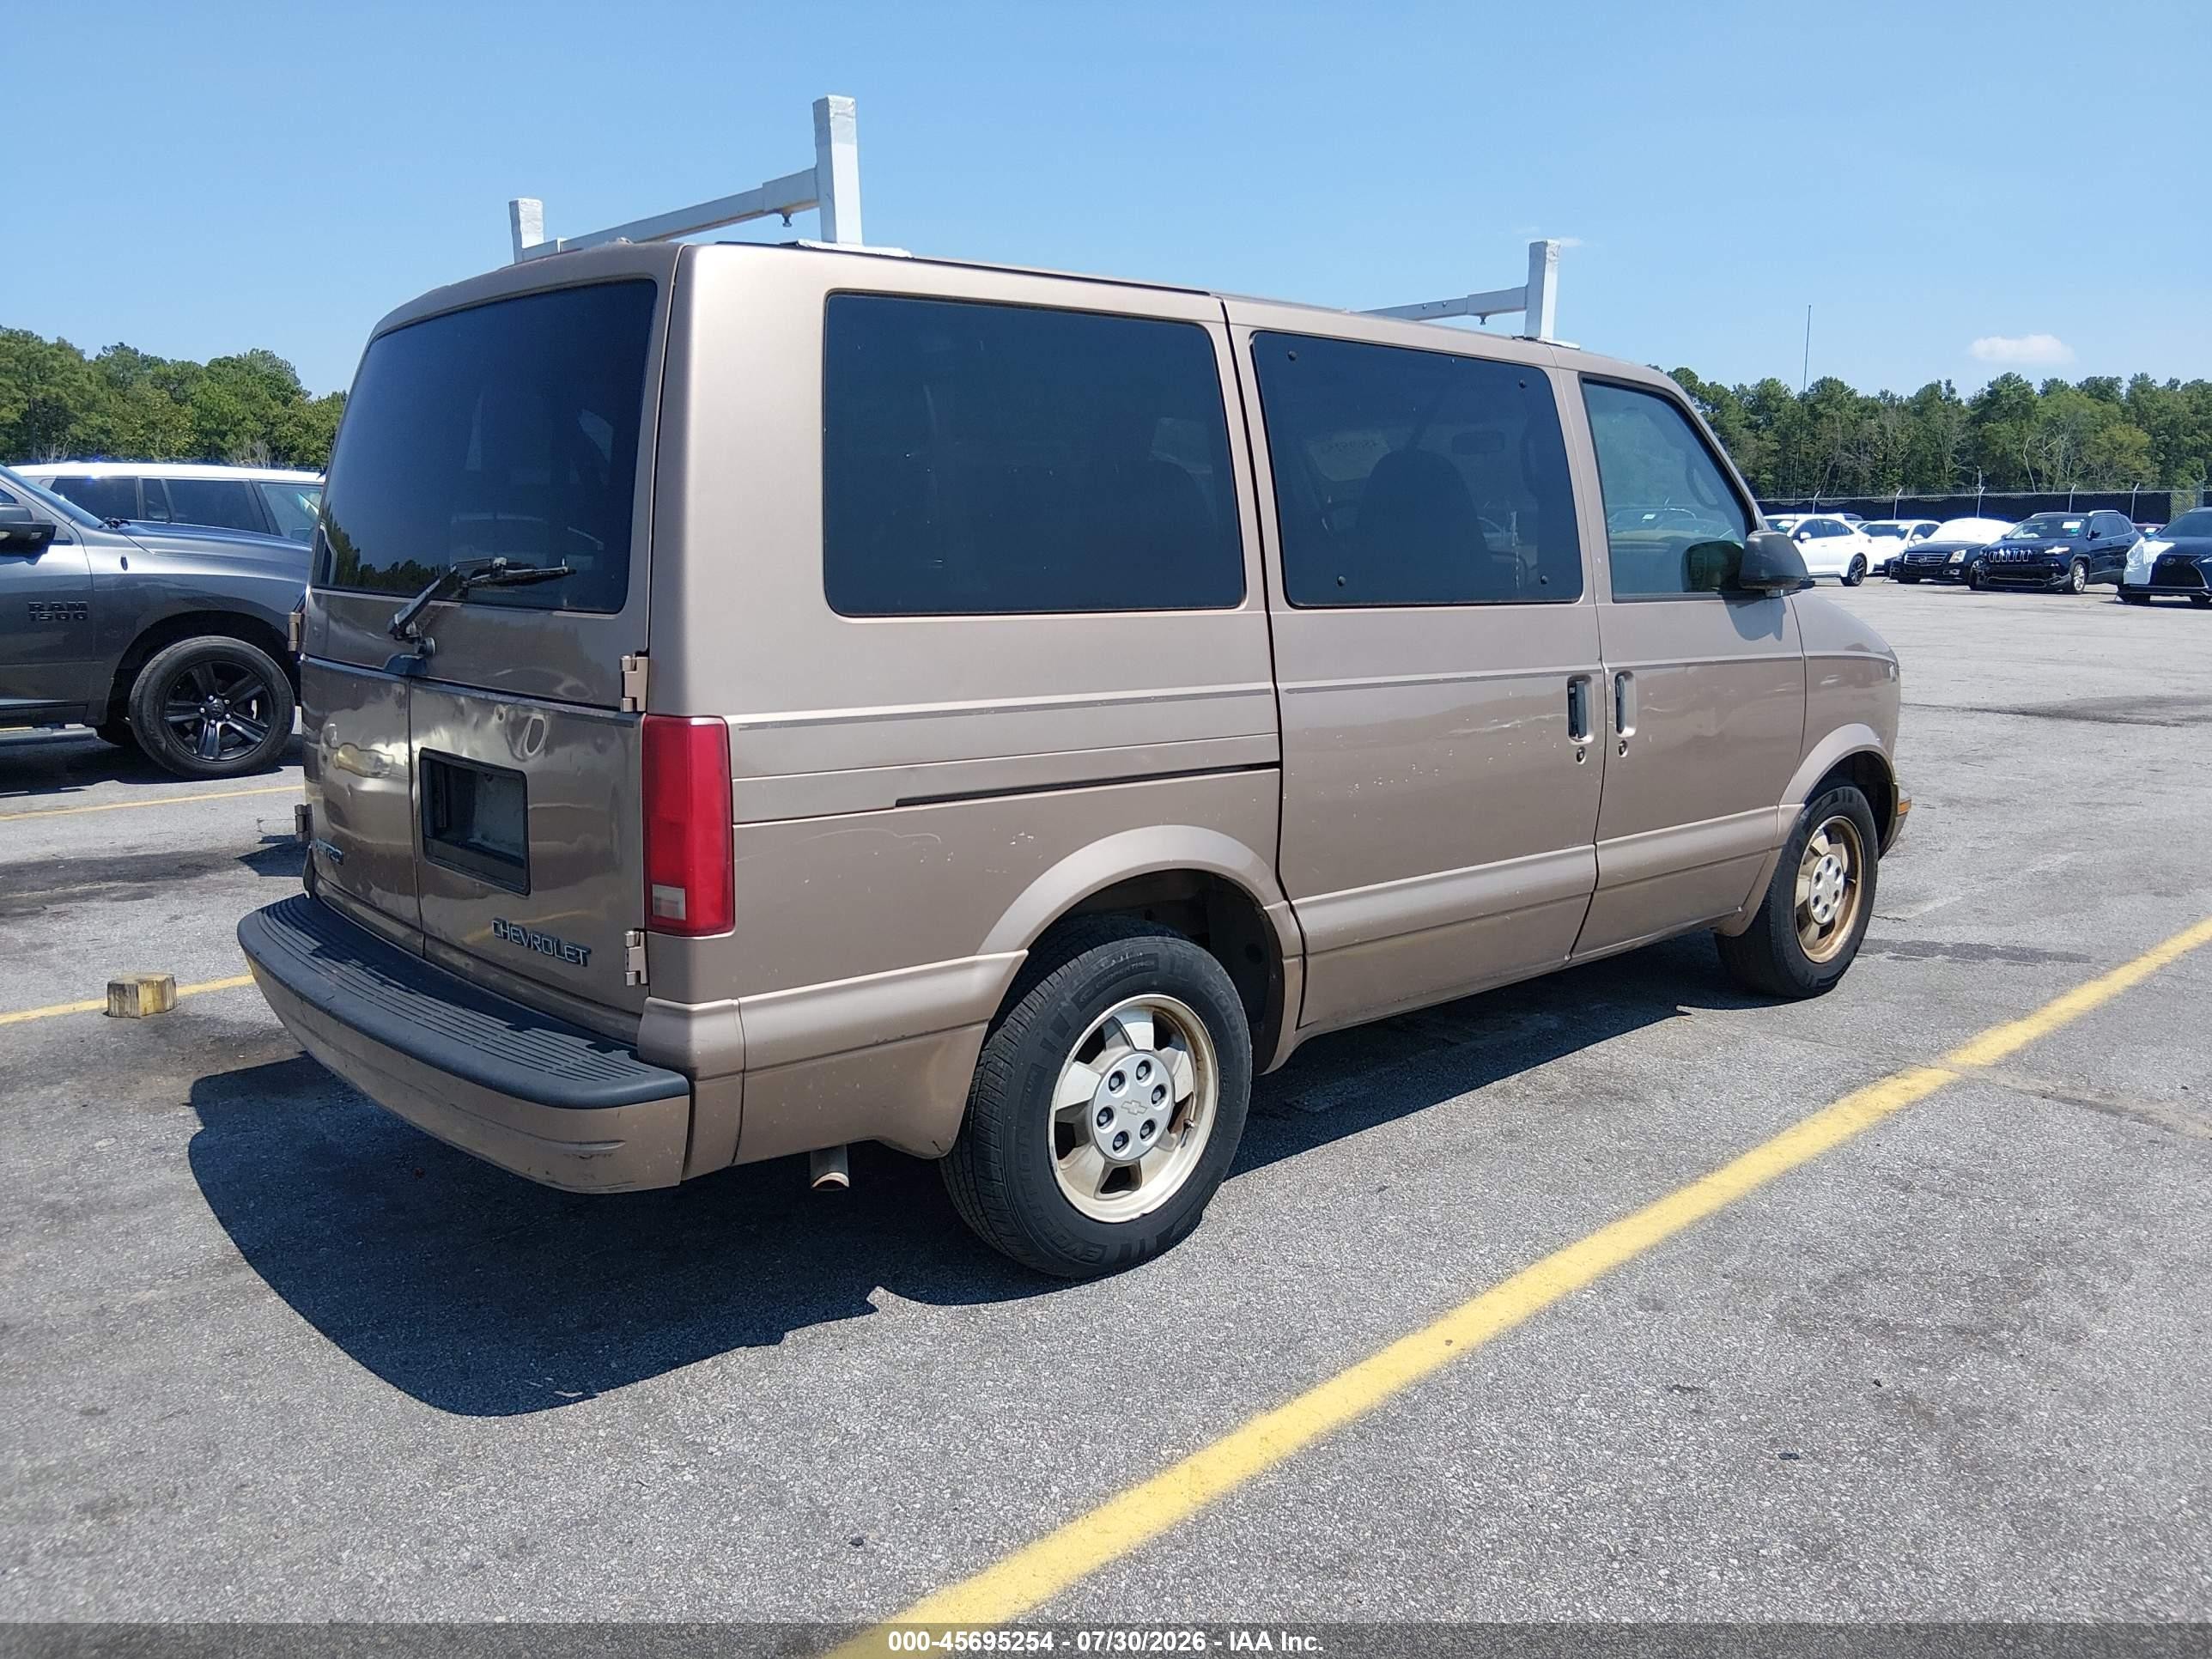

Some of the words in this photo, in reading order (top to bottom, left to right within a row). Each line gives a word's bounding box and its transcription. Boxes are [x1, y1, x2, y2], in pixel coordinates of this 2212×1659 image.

[28, 601, 88, 611] RAM
[28, 611, 88, 621] 1500
[492, 917, 591, 967] CHEVROLET
